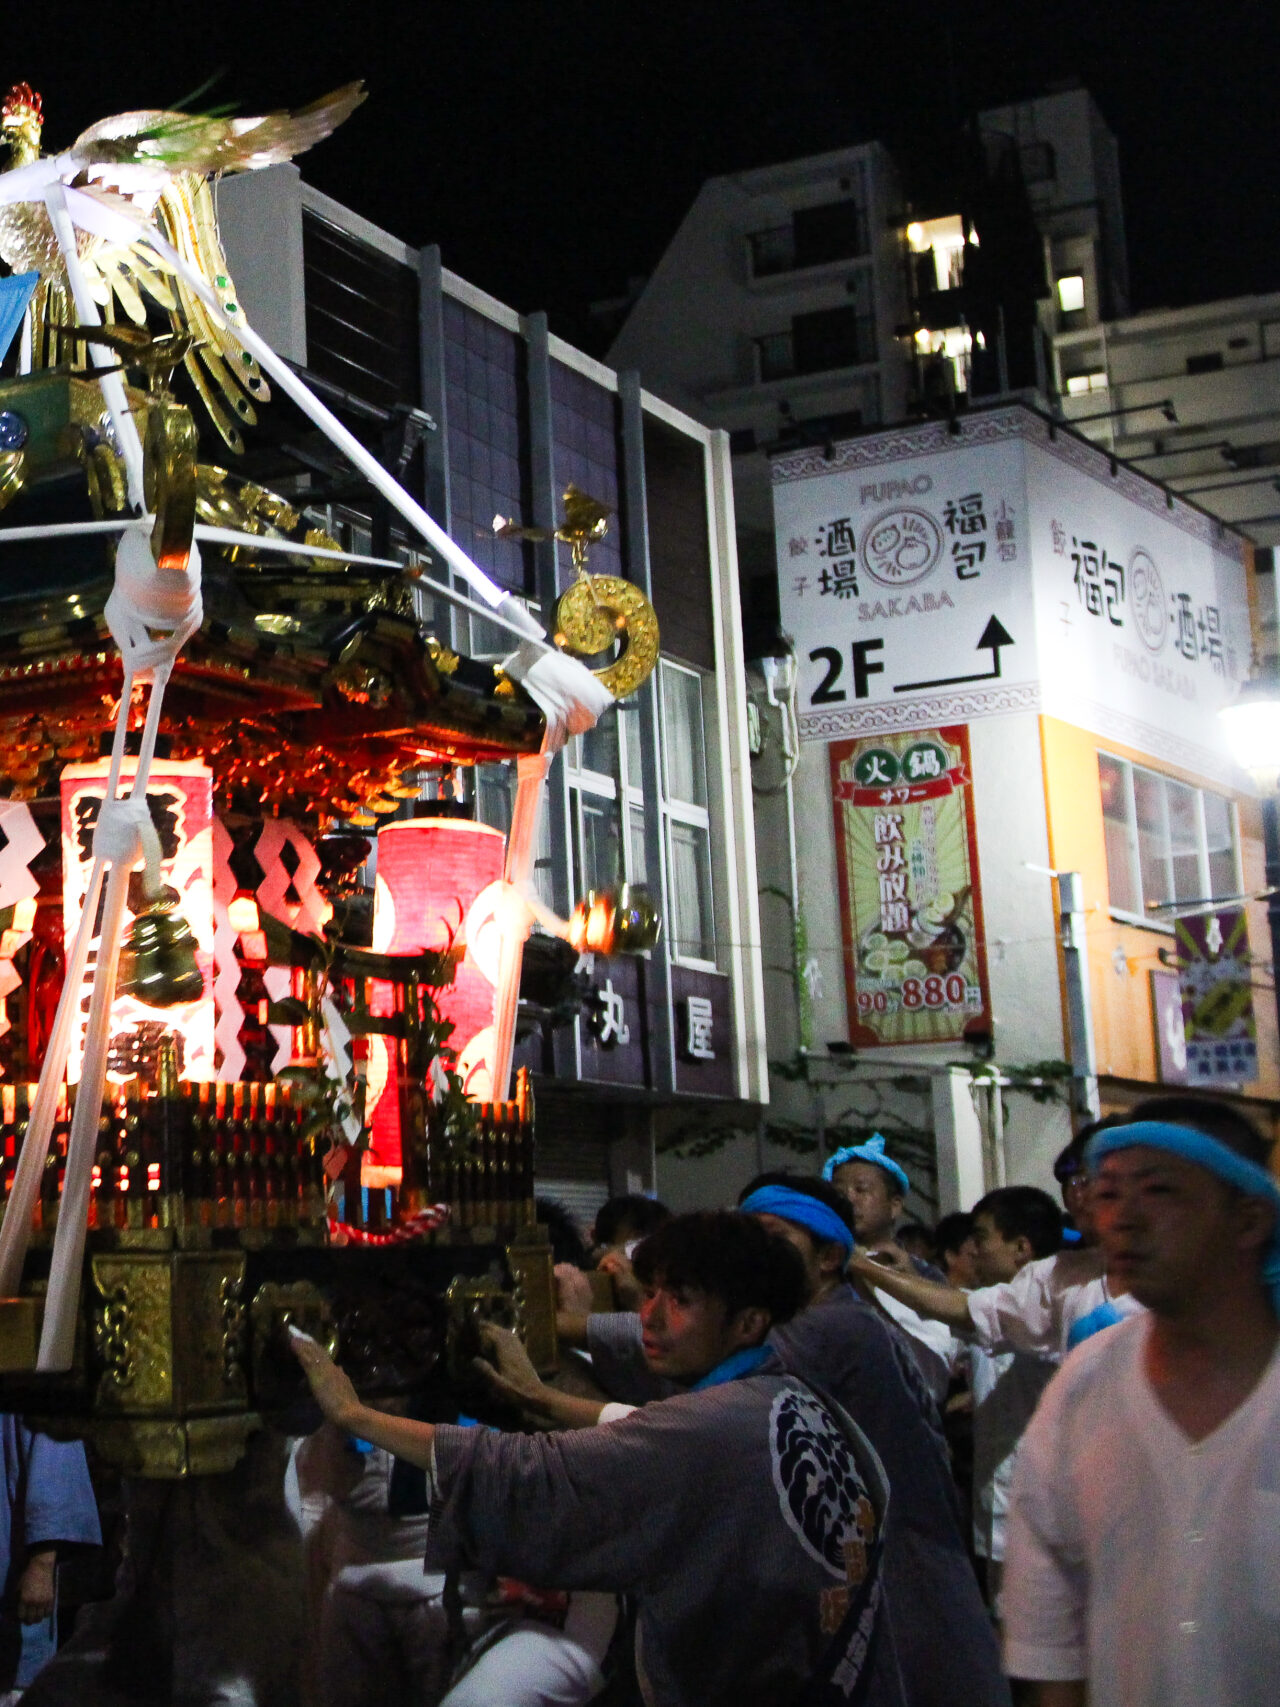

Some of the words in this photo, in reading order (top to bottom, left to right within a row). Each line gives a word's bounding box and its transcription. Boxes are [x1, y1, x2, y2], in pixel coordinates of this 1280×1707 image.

[859, 474, 933, 505] FUPAO
[815, 517, 860, 600] 酒場
[943, 492, 987, 581] 福包
[858, 590, 956, 622] SAKABA
[808, 638, 885, 705] 2F
[865, 749, 941, 784] 火鍋
[879, 787, 928, 805] サワー
[874, 813, 910, 932] 飲み放題
